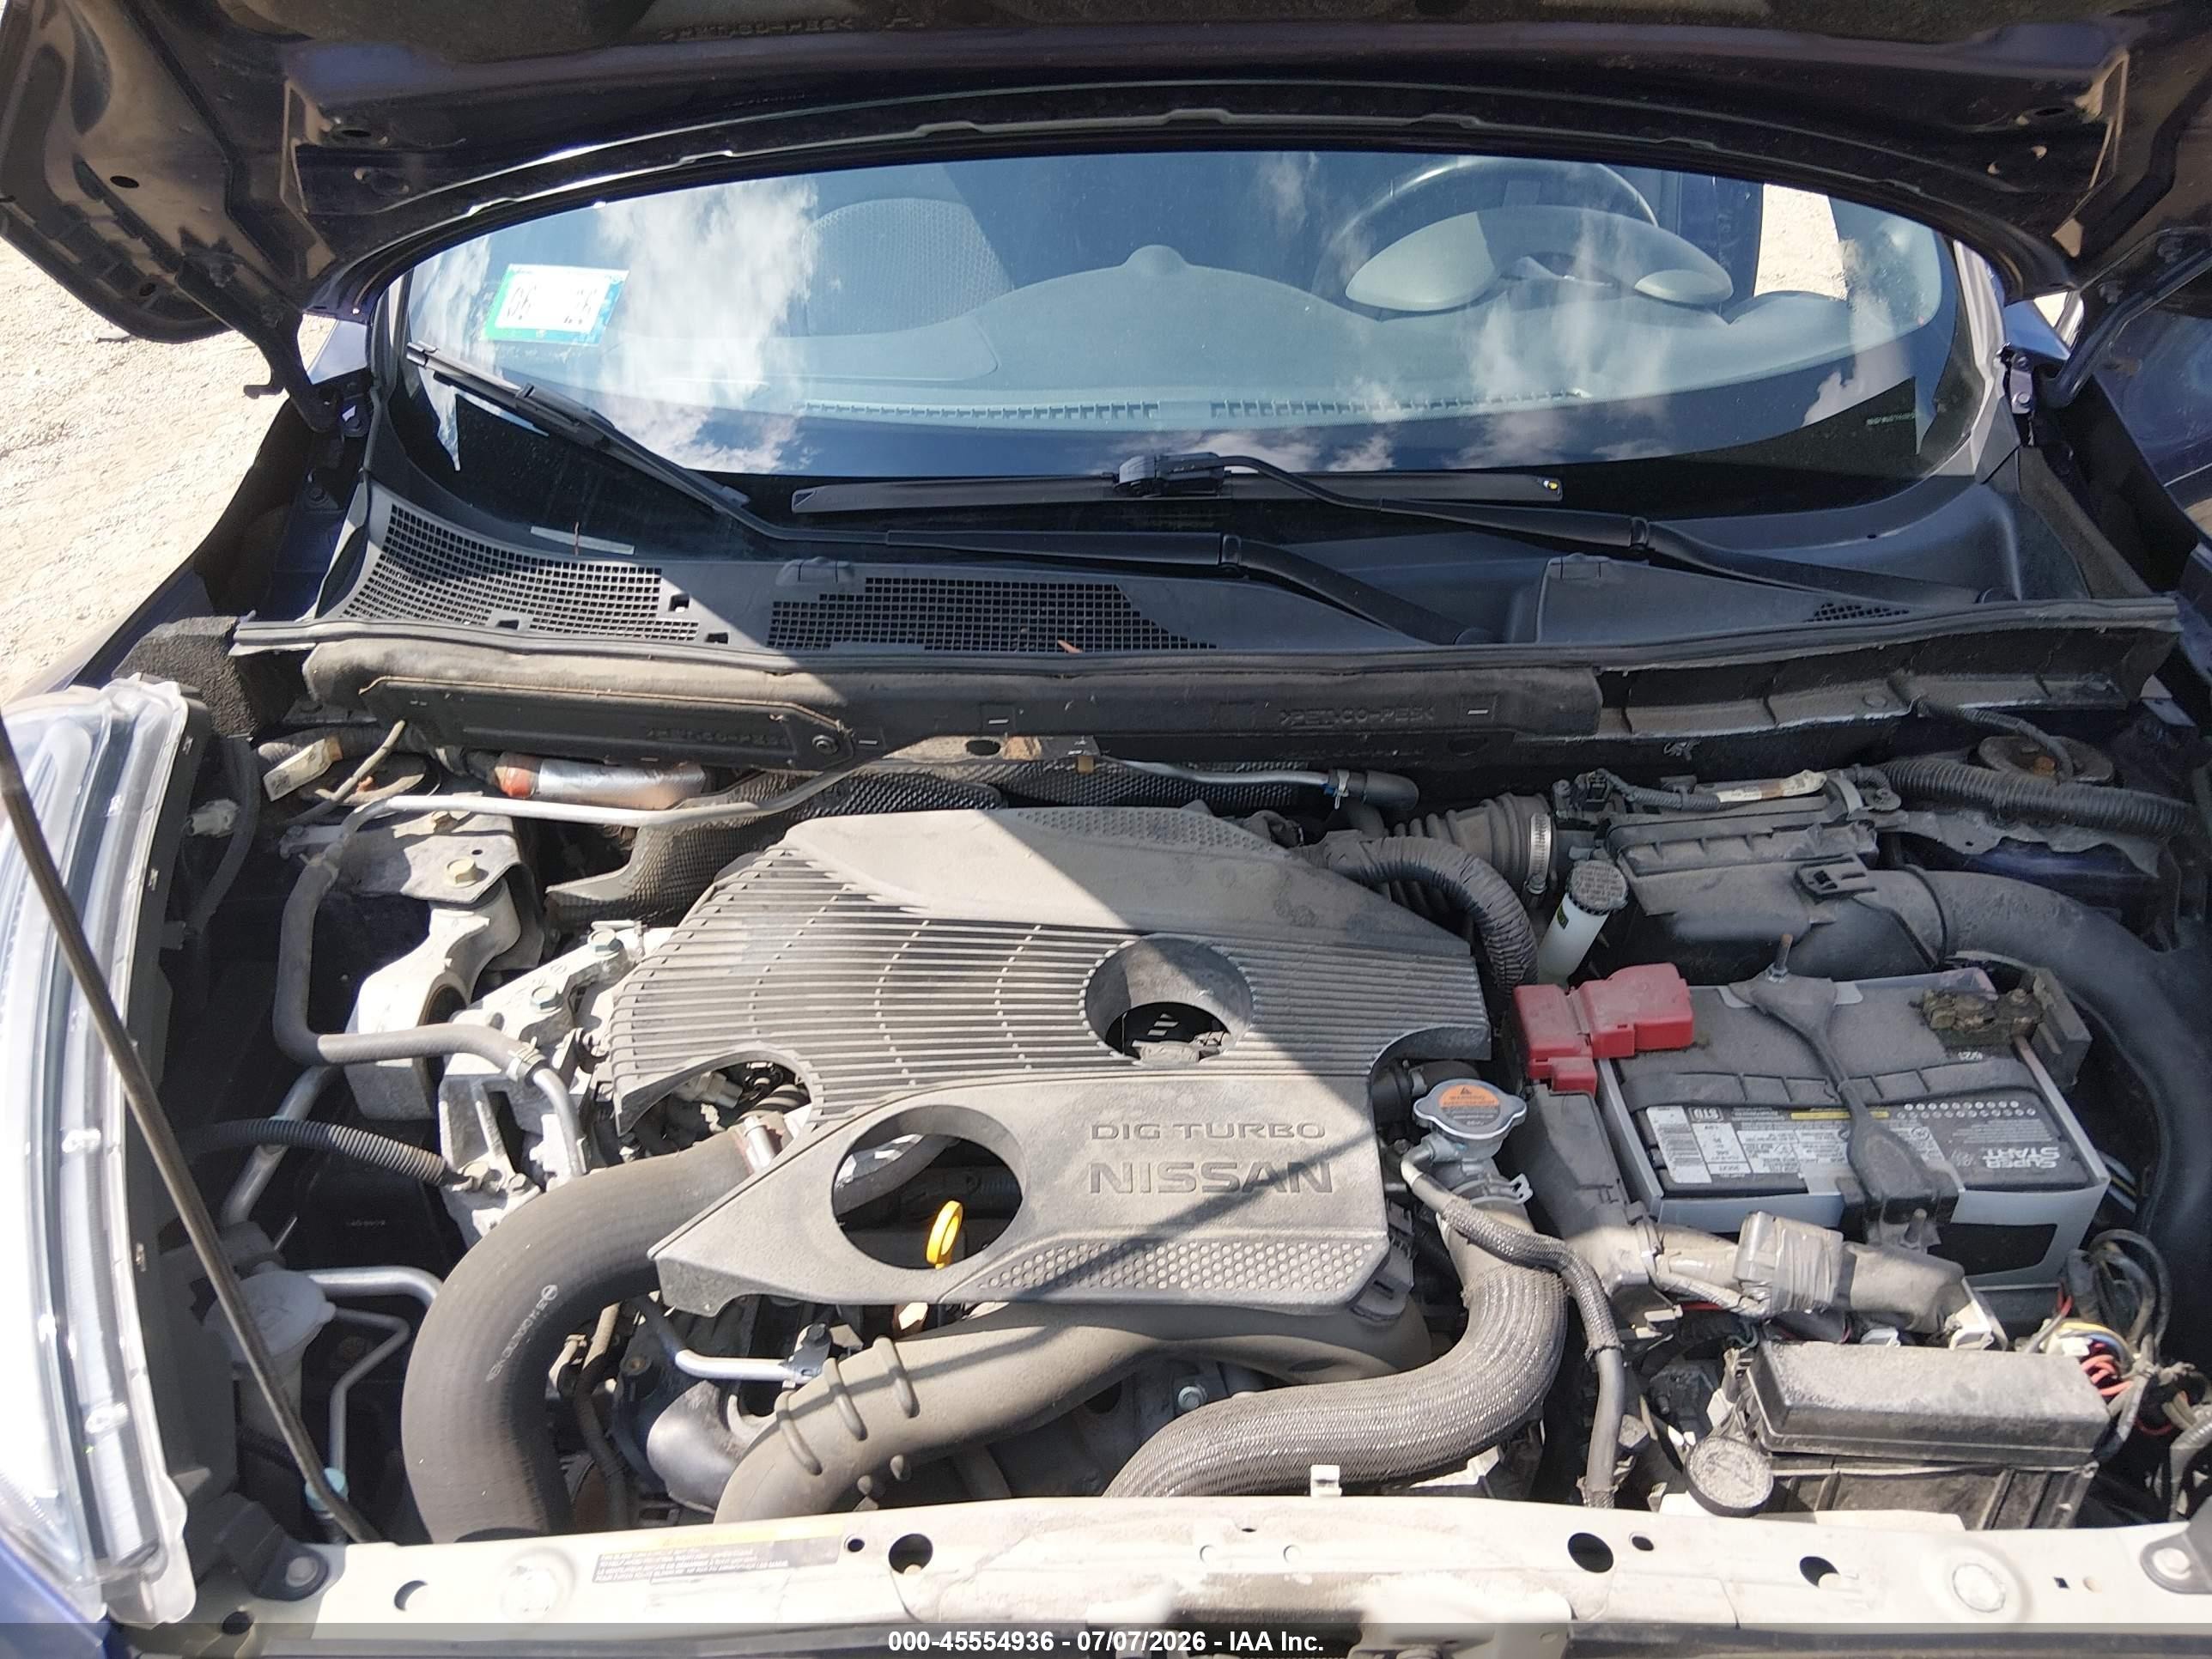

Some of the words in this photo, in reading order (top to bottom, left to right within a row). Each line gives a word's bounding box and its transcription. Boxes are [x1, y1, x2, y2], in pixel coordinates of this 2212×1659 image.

[1091, 1123, 1161, 1140] DIG
[1173, 1122, 1327, 1139] TURBO
[1982, 1146, 2061, 1160] START
[1985, 1157, 2057, 1169] SUPER
[1090, 1161, 1334, 1194] NISSAN
